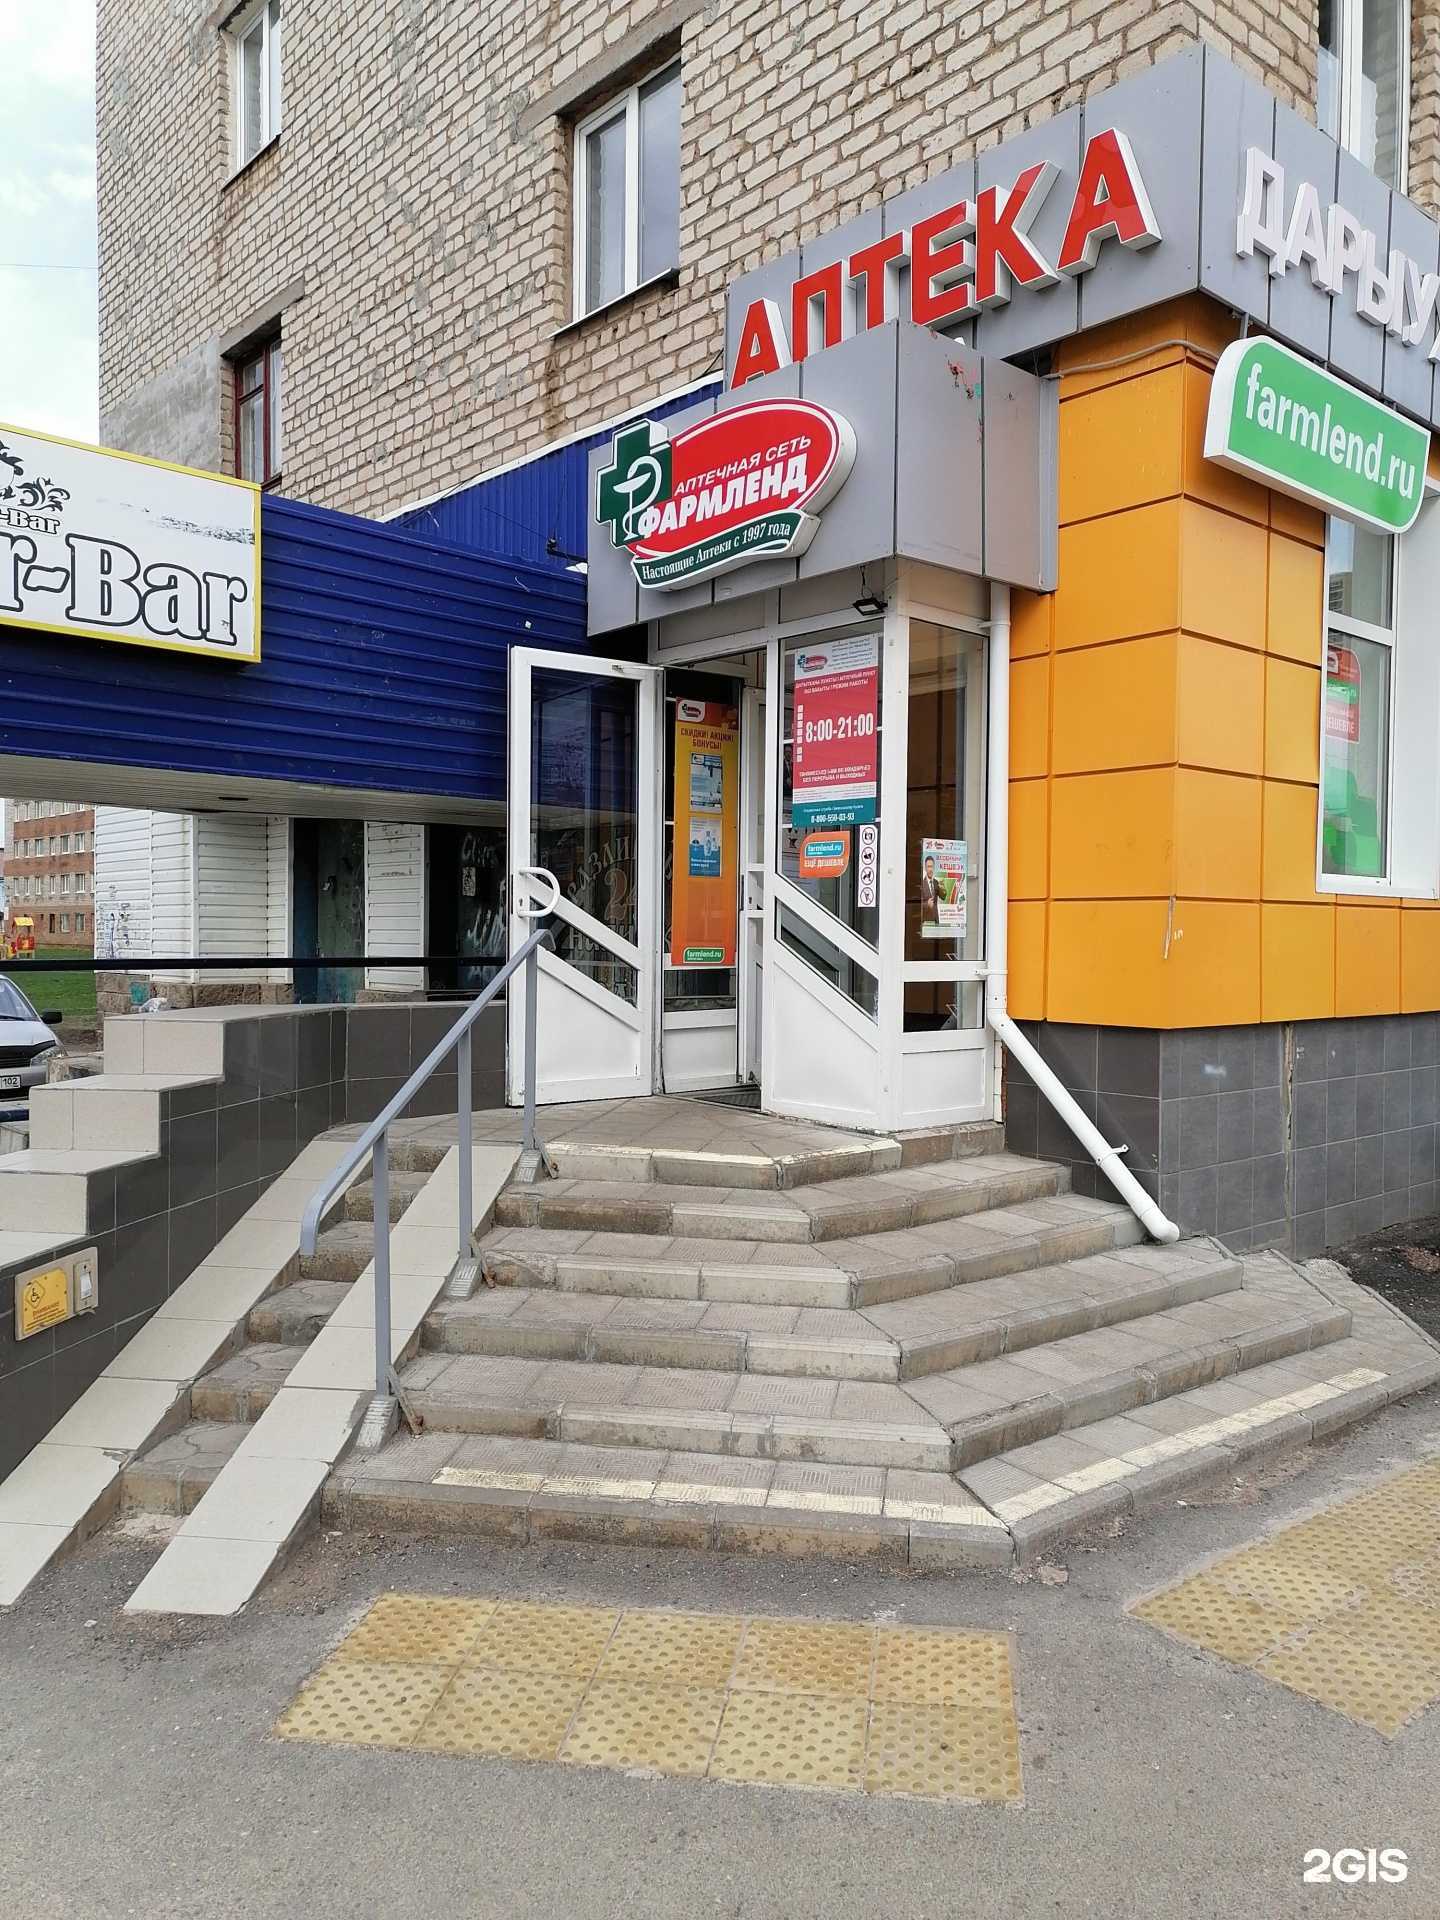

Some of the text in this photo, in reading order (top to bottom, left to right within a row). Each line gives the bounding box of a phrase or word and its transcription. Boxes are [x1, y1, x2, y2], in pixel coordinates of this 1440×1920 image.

[730, 127, 1162, 390] АПТЕКА
[1237, 147, 1440, 363] ДАРЫУ
[674, 436, 812, 497] АПТЕЧНАЯ СЕТЬ
[1246, 363, 1416, 498] farmlend.ru
[637, 453, 808, 539] ФАРМЛЕНД
[642, 521, 792, 580] Настоящие Аптеки с 1997 года
[805, 712, 874, 743] 8:00-21:00
